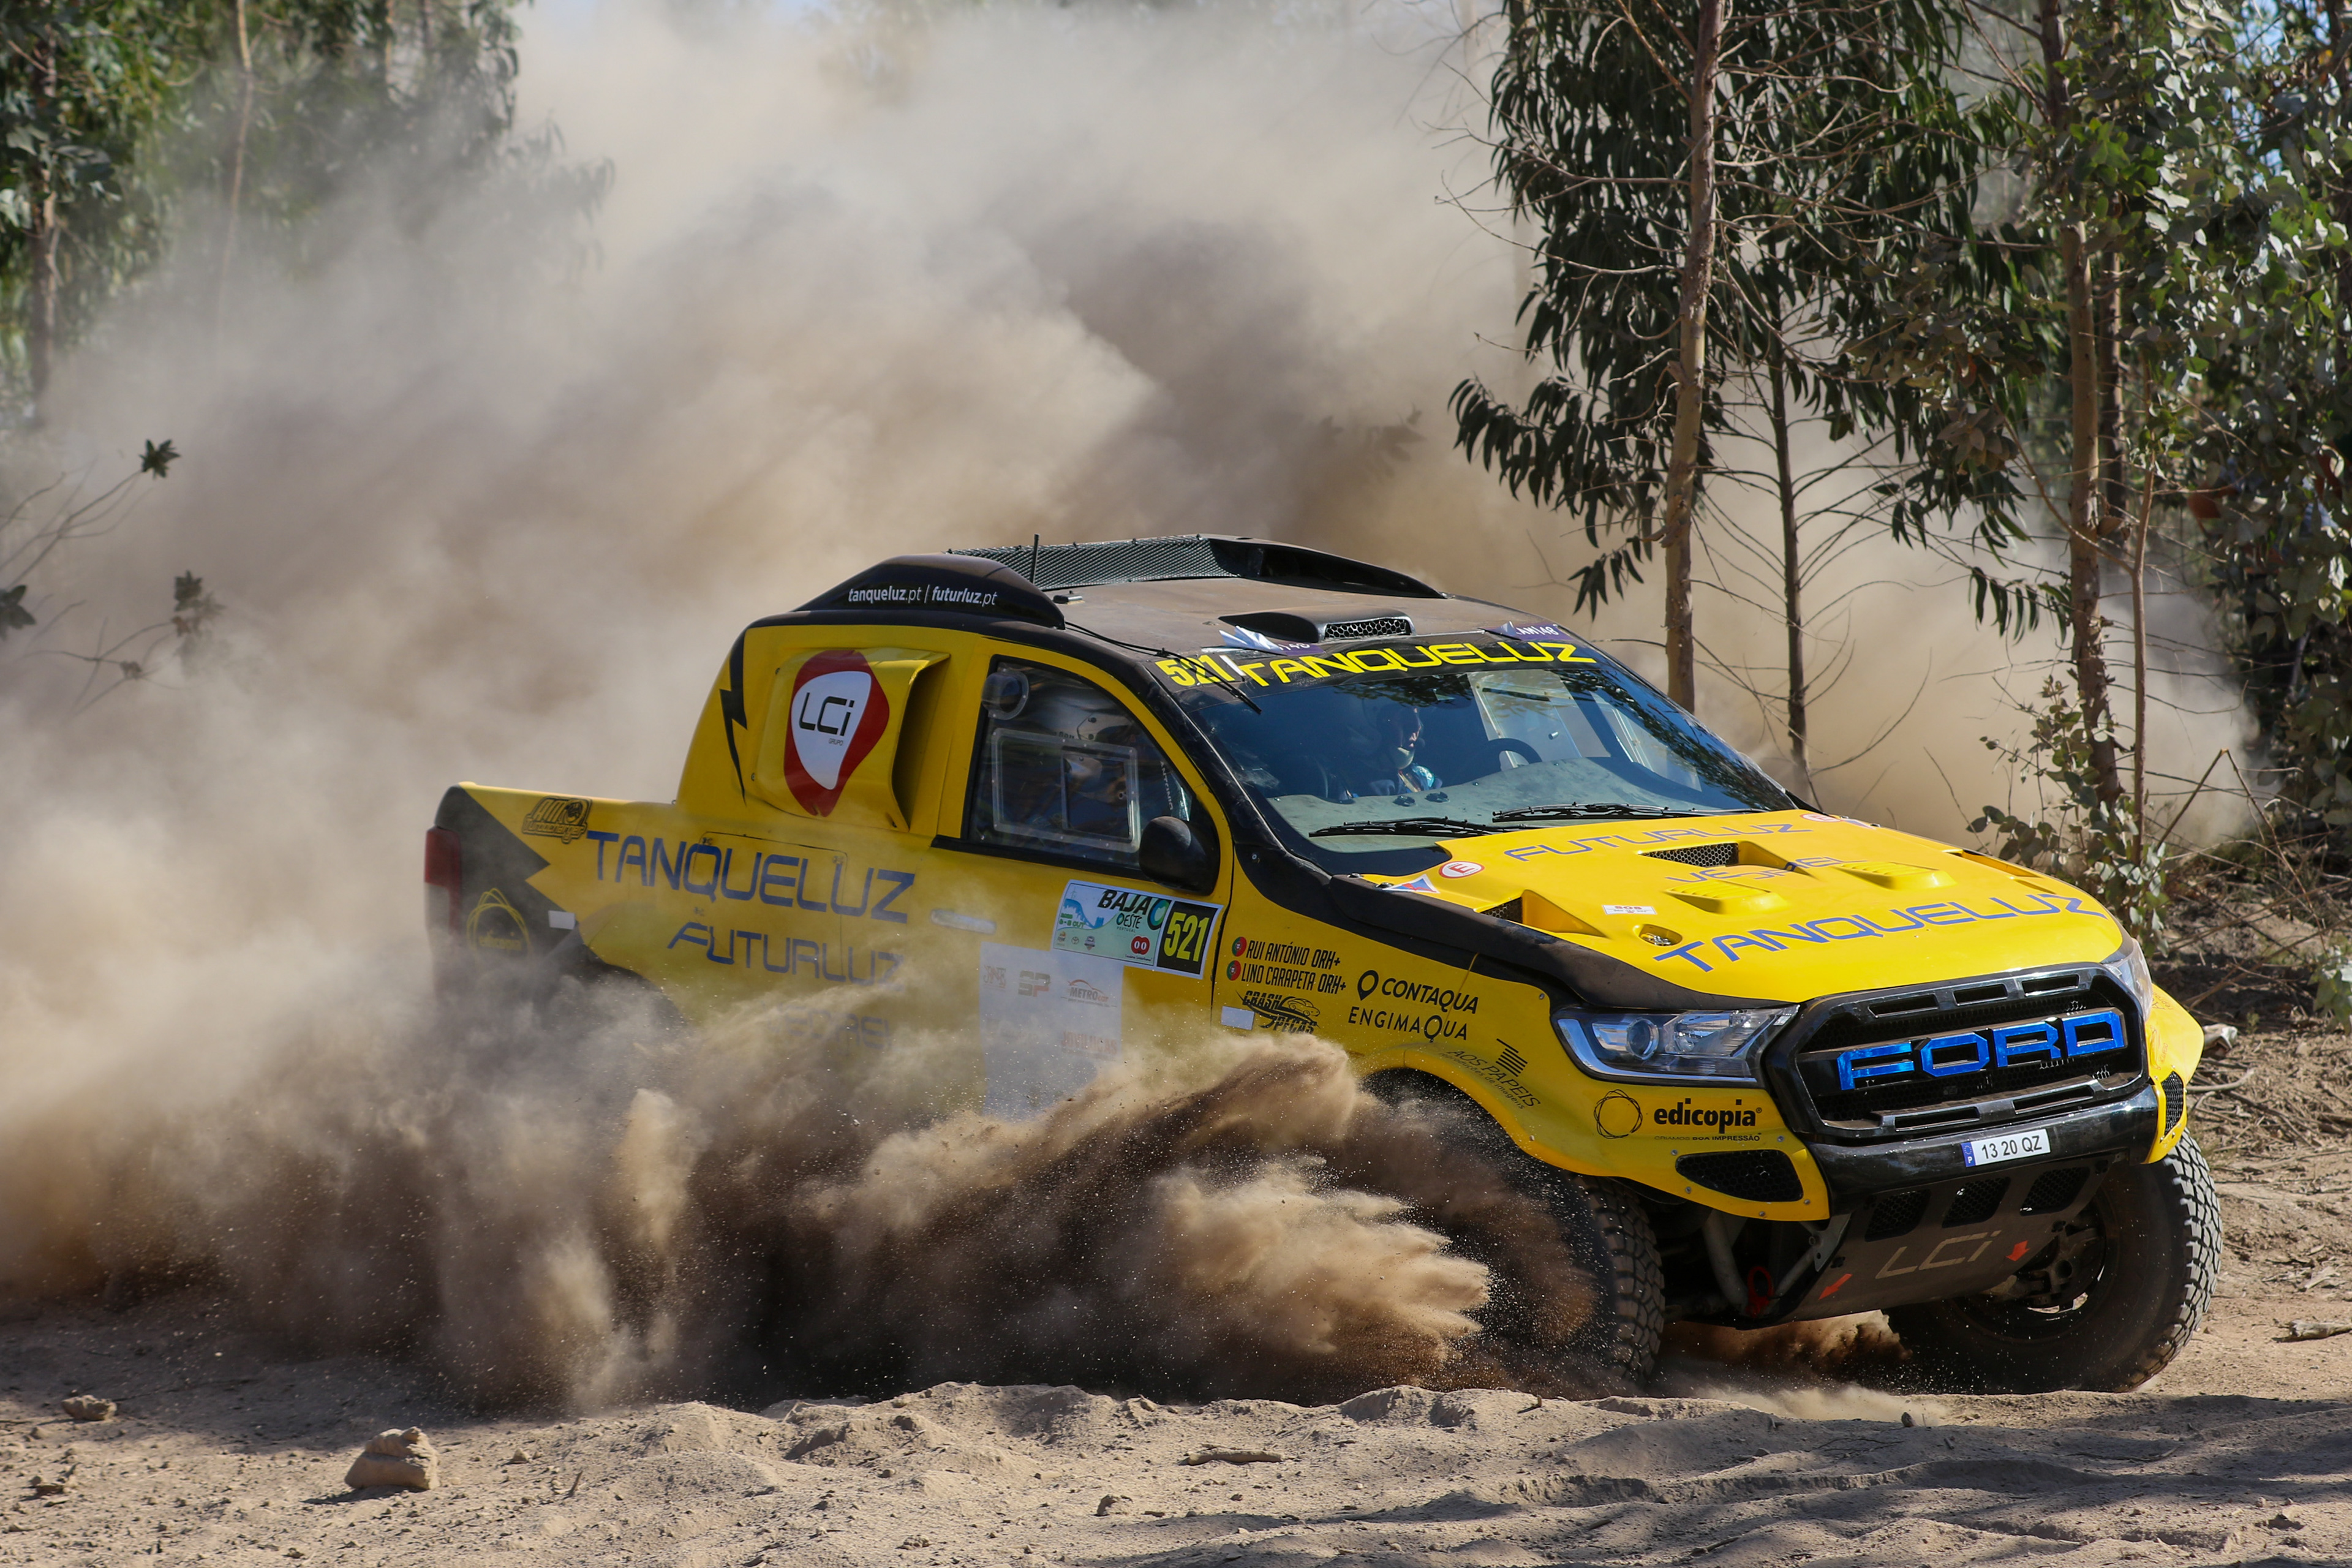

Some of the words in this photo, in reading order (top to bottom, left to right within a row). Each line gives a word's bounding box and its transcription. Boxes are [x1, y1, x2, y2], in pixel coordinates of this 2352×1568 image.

[848, 586, 922, 603] tanqueluz.pt
[932, 586, 997, 607] futurluz.pt
[1155, 655, 1235, 686] 521
[1238, 641, 1597, 687] TANQUELUZ
[828, 737, 843, 746] GRUPO
[1504, 823, 1814, 862] FUTURLUZ
[586, 830, 915, 924] TANQUELUZ
[1449, 864, 1476, 873] E
[1098, 889, 1152, 915] BAJA
[1116, 913, 1142, 929] OESTE
[1164, 911, 1210, 962] 521
[1654, 892, 2108, 973] TANQUELUZ
[667, 921, 905, 991] FUTURLUZ
[1246, 940, 1265, 959] RUI
[1265, 941, 1310, 966] ANTÓNIO
[1311, 949, 1340, 970] ORH+
[1241, 963, 1264, 984] LINO
[1265, 966, 1316, 991] CARAPETA
[1317, 973, 1346, 994] ORH+
[1381, 978, 1479, 1014] CONTAQUA
[1242, 990, 1283, 1010] CRASH
[1348, 1006, 1468, 1042] ENGIMAQUA
[1838, 1011, 2124, 1090] FORD
[1447, 1050, 1488, 1066] AOS
[1481, 1065, 1541, 1107] PAPEIS
[1981, 1143, 1999, 1159] 13
[2001, 1139, 2018, 1156] 20
[2022, 1135, 2042, 1152] QZ
